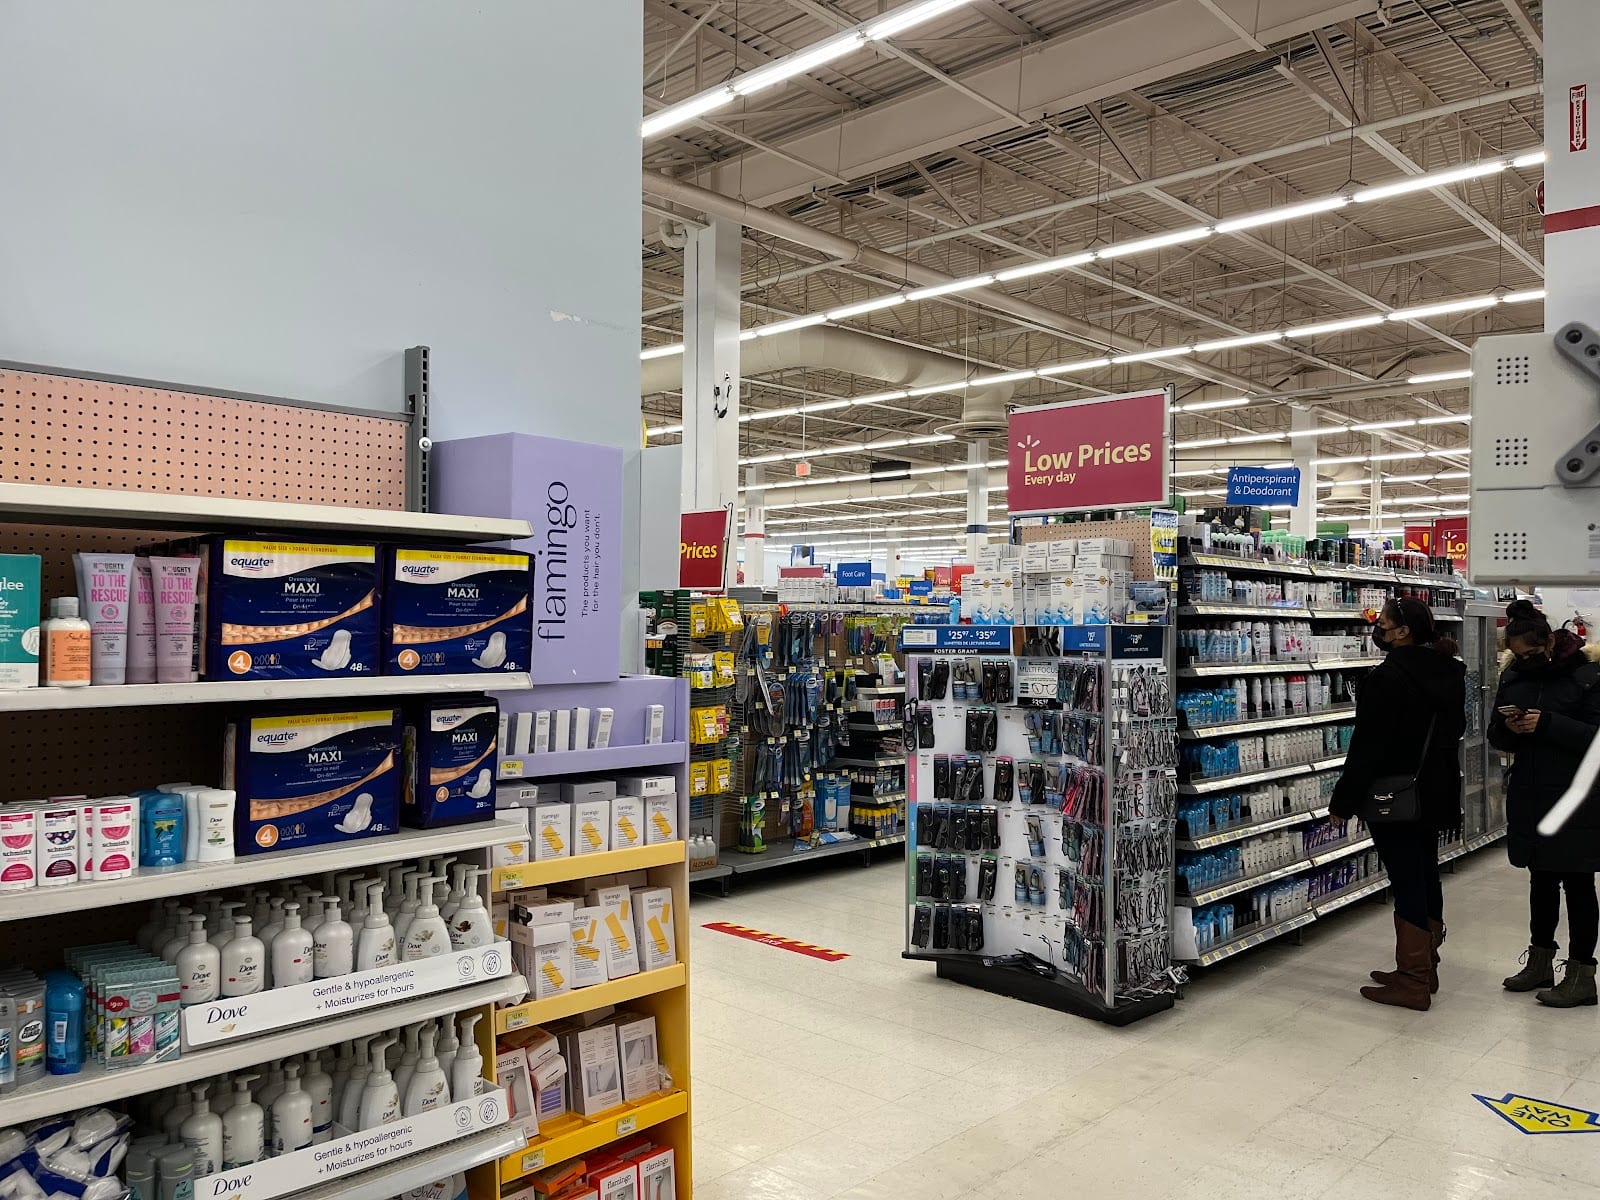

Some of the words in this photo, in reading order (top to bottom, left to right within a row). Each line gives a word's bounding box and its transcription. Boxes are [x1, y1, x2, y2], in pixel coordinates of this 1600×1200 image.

[1025, 450, 1072, 473] Low
[1078, 441, 1152, 468] Prices
[1024, 474, 1054, 486] Every
[1056, 471, 1076, 485] day
[1232, 473, 1297, 485] Antiperspirant
[1234, 486, 1242, 495] &
[1243, 486, 1292, 497] Deodorant
[594, 543, 602, 560] you
[680, 542, 718, 559] Prices
[1447, 541, 1468, 553] Lo
[231, 556, 270, 568] equate
[537, 481, 578, 643] flamingo
[402, 565, 435, 574] equate
[842, 570, 852, 578] Foot
[853, 570, 865, 578] Care
[91, 574, 105, 587] TO
[107, 575, 126, 588] THE
[161, 577, 174, 590] TO
[175, 577, 193, 590] THE
[583, 557, 591, 597] products
[284, 582, 320, 593] MAXI
[447, 588, 479, 598] MAXI
[91, 589, 127, 603] RESCUE
[160, 591, 194, 604] RESCUE
[592, 599, 600, 612] for
[234, 655, 245, 669] 4
[402, 653, 414, 666] 4
[504, 662, 515, 670] 48
[350, 663, 363, 671] 48
[257, 732, 295, 745] equate
[452, 732, 478, 743] MAXI
[308, 751, 342, 764] MAXI
[370, 823, 383, 832] 48
[260, 829, 272, 843] 4
[375, 954, 389, 963] Dove
[239, 964, 257, 973] Dove
[192, 972, 211, 980] Dove
[312, 984, 343, 997] Gentle
[344, 982, 351, 990] &
[353, 969, 414, 990] hypoallergenic
[325, 991, 375, 1009] Moisturizes
[377, 989, 389, 998] for
[391, 983, 414, 995] hours
[207, 1005, 248, 1024] Dove
[421, 1097, 437, 1106] Dove
[1509, 1109, 1570, 1127] ONE
[1516, 1104, 1571, 1122] WAY
[314, 1147, 343, 1161] Gentle
[345, 1143, 352, 1152] &
[353, 1125, 413, 1150] hypoallergenic
[326, 1152, 375, 1173] Moisturizes
[376, 1147, 388, 1156] for
[389, 1138, 413, 1151] hours
[645, 1157, 669, 1172] flamingo
[213, 1174, 252, 1196] Dove
[607, 1173, 632, 1190] flamingo
